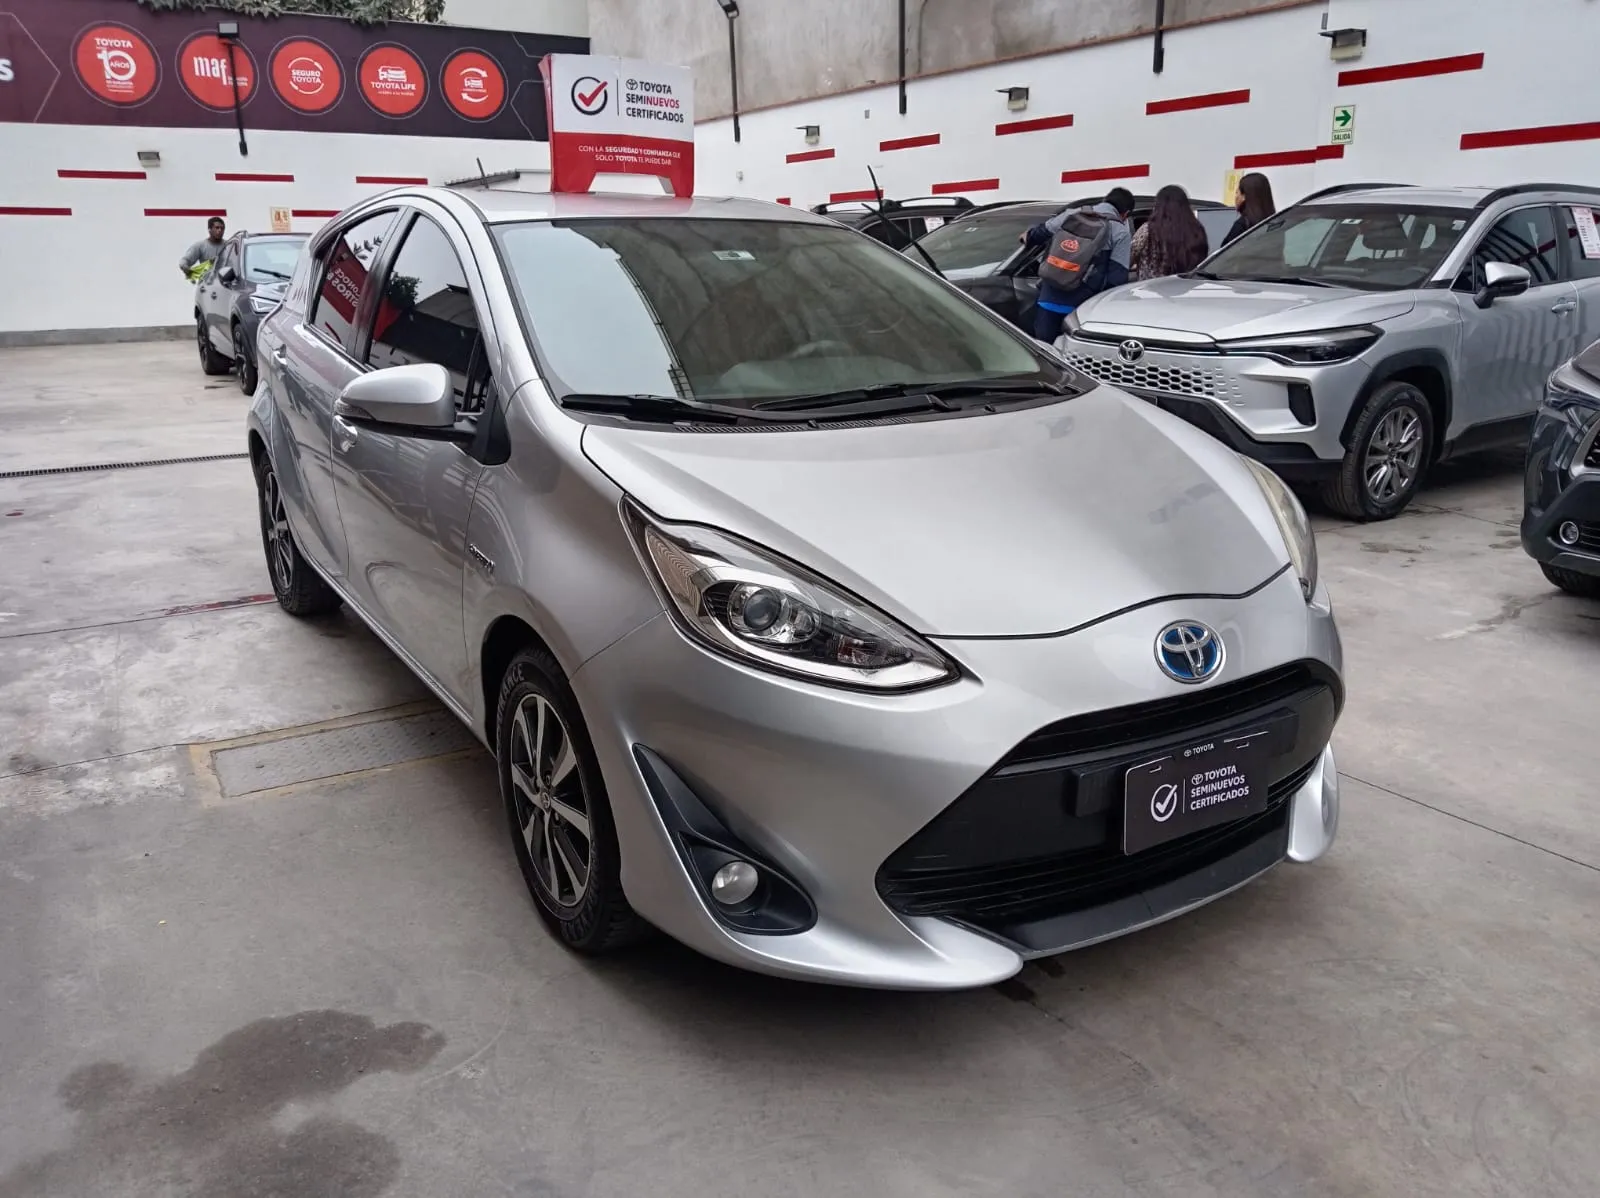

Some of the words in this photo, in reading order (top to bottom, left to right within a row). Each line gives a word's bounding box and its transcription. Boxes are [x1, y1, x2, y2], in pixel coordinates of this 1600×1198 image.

[95, 37, 133, 48] TOYOTA
[193, 56, 227, 86] maf
[291, 69, 321, 77] SEGURO
[292, 76, 322, 84] TOYOTA
[370, 81, 400, 90] TOYOTA
[401, 82, 417, 90] LIFE
[639, 81, 672, 95] TOYOTA
[626, 93, 680, 109] SEMINUEVOS
[626, 107, 684, 123] CERTIFICADOS
[605, 146, 638, 154] SEGURIDAD
[1192, 743, 1215, 755] TOYOTA
[1204, 764, 1237, 781] TOYOTA
[1190, 774, 1246, 798] SEMINUEVOS
[1190, 785, 1250, 811] CERTIFICADOS
